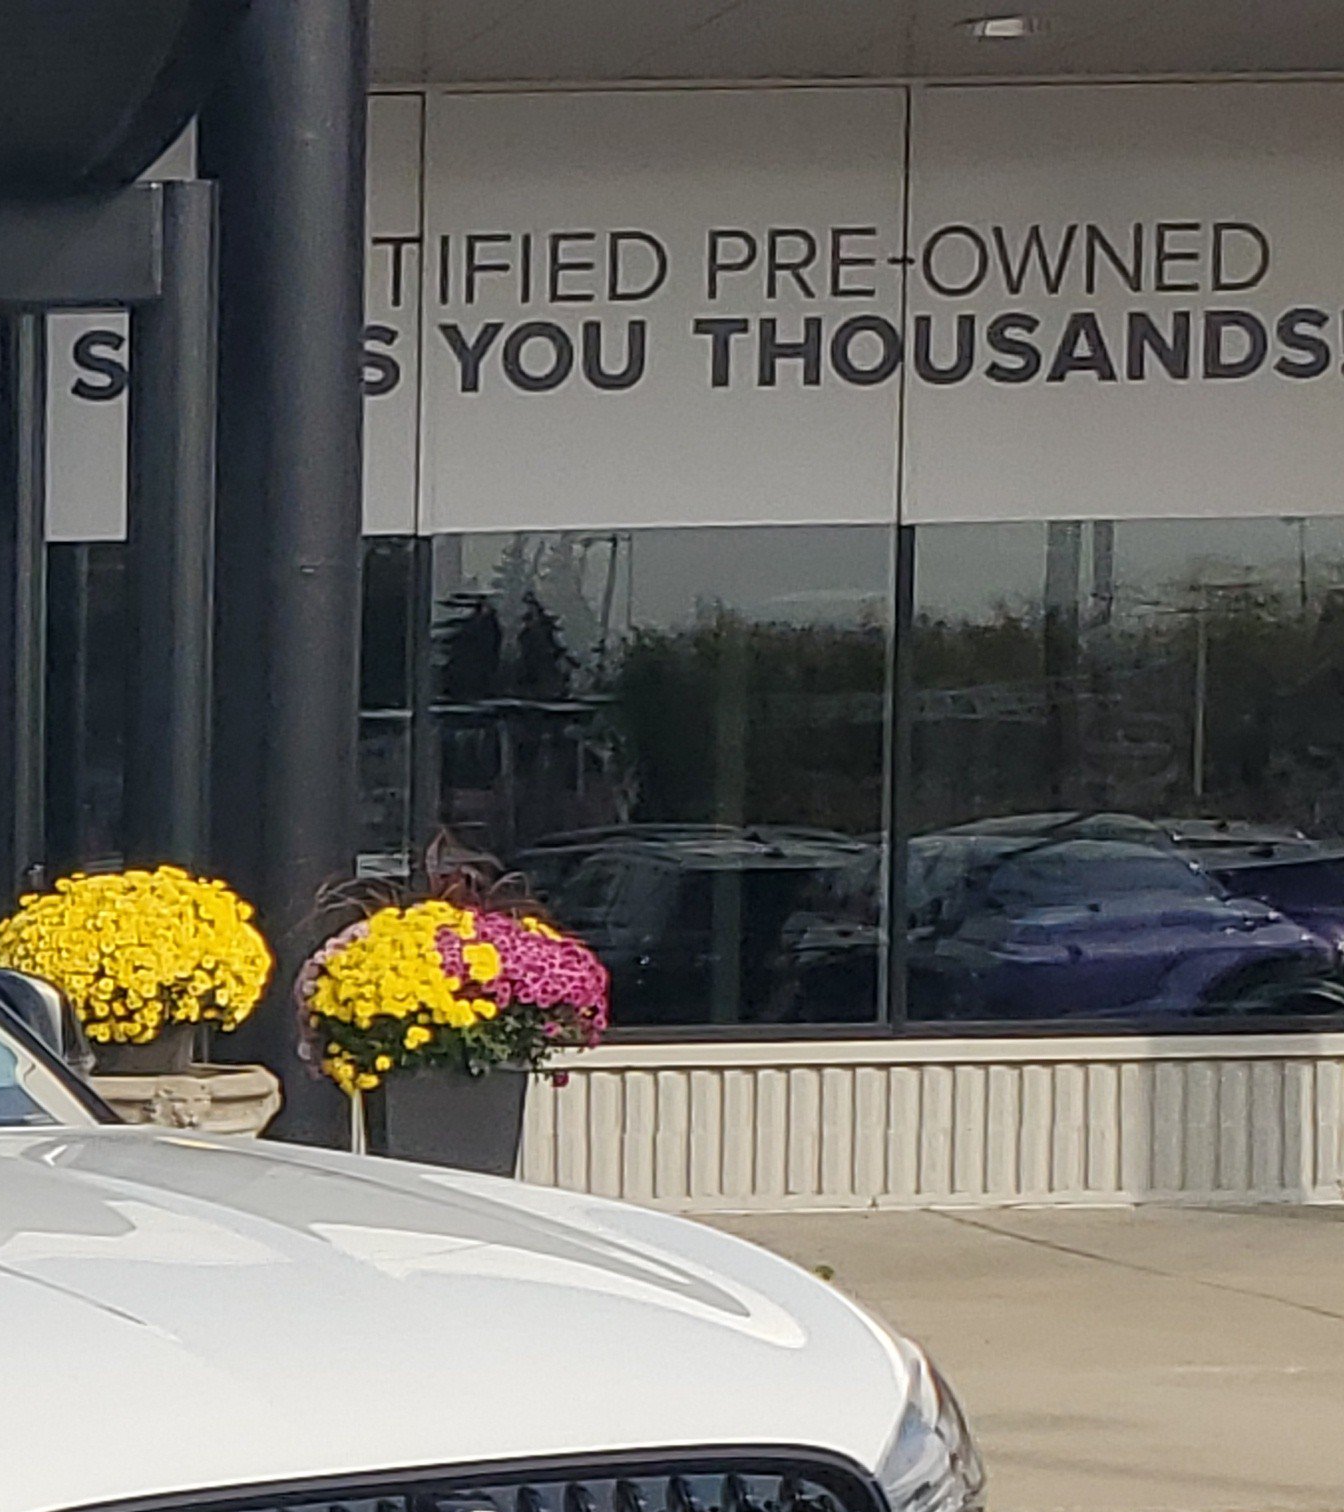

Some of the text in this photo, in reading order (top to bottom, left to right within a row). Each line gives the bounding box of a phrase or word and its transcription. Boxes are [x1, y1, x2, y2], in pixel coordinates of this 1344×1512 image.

[371, 222, 1271, 307] TIFIED PRE-OWNED
[438, 319, 647, 394] YOU
[693, 308, 1344, 388] THOUSANDS
